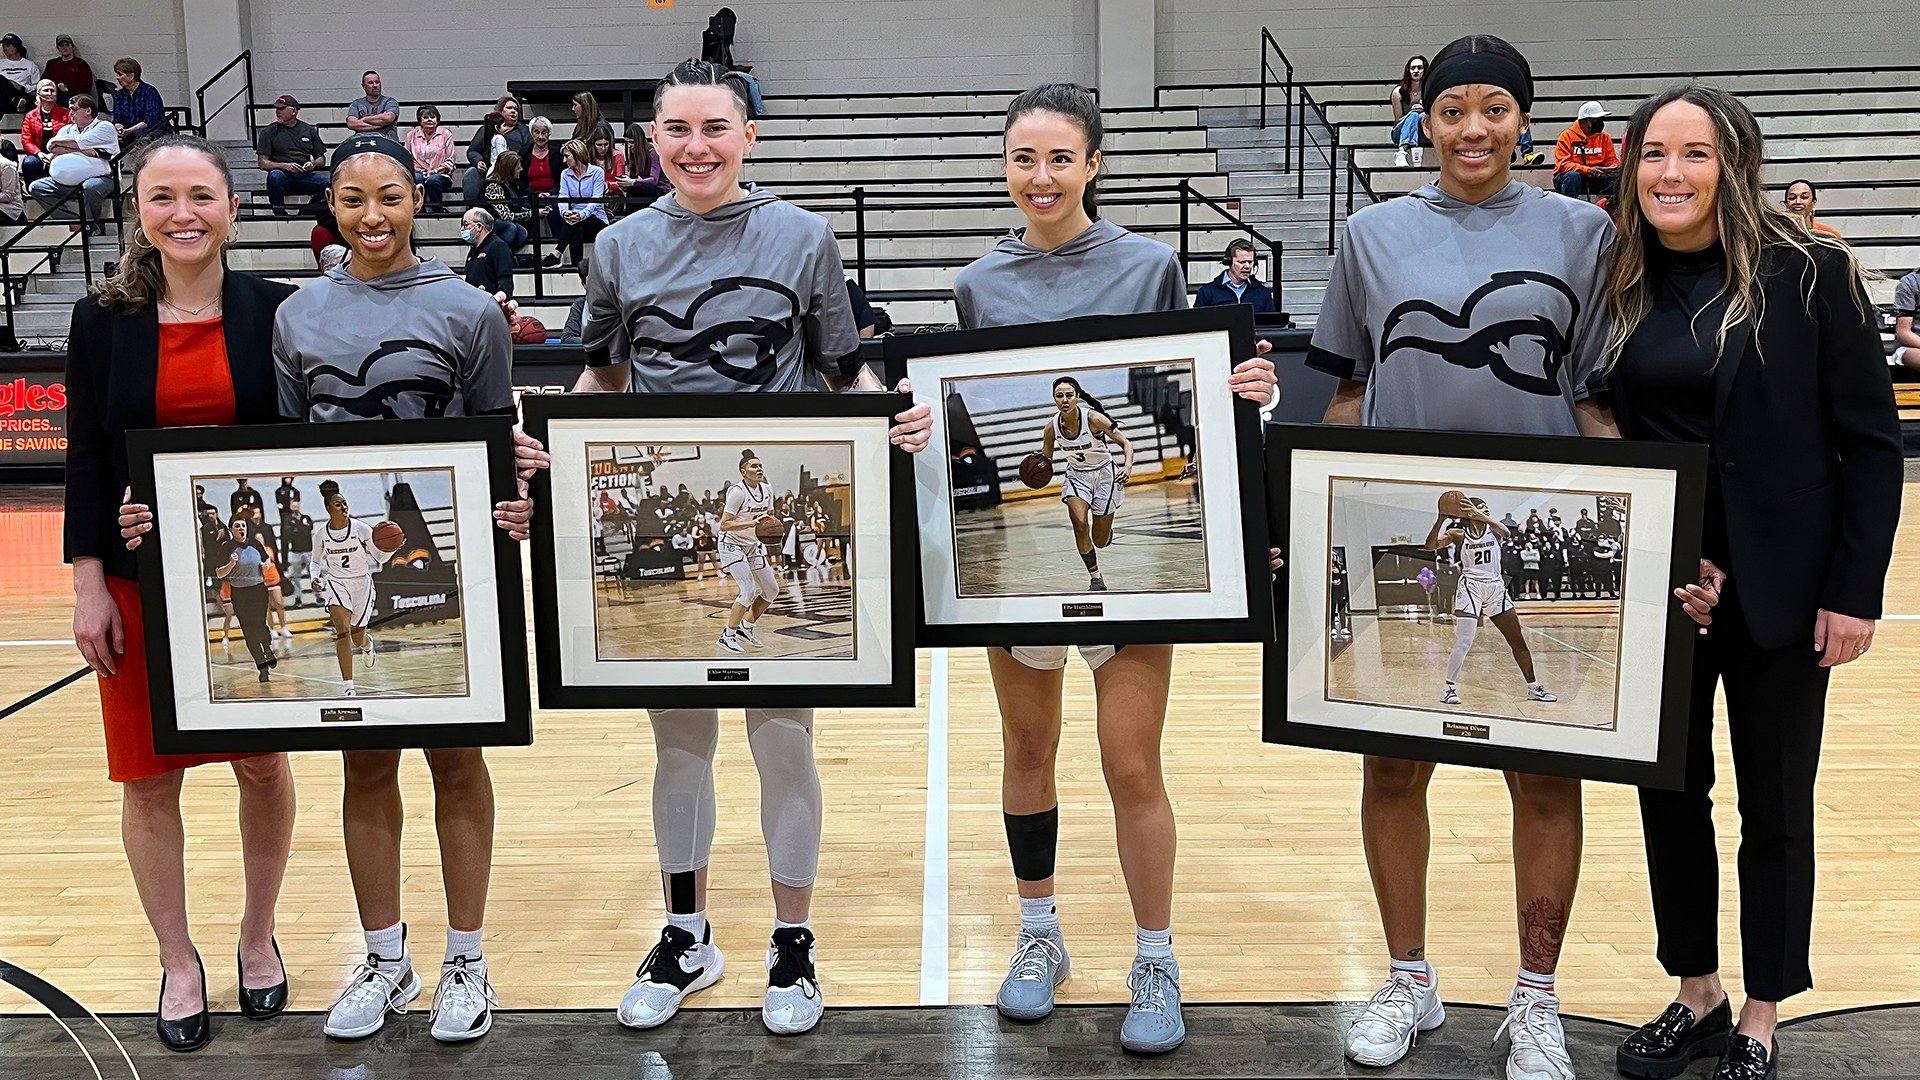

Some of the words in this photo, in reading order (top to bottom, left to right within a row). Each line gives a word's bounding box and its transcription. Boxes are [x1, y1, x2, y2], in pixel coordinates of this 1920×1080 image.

[15, 437, 68, 451] SAVING
[341, 555, 350, 568] 2
[1474, 549, 1492, 566] 20
